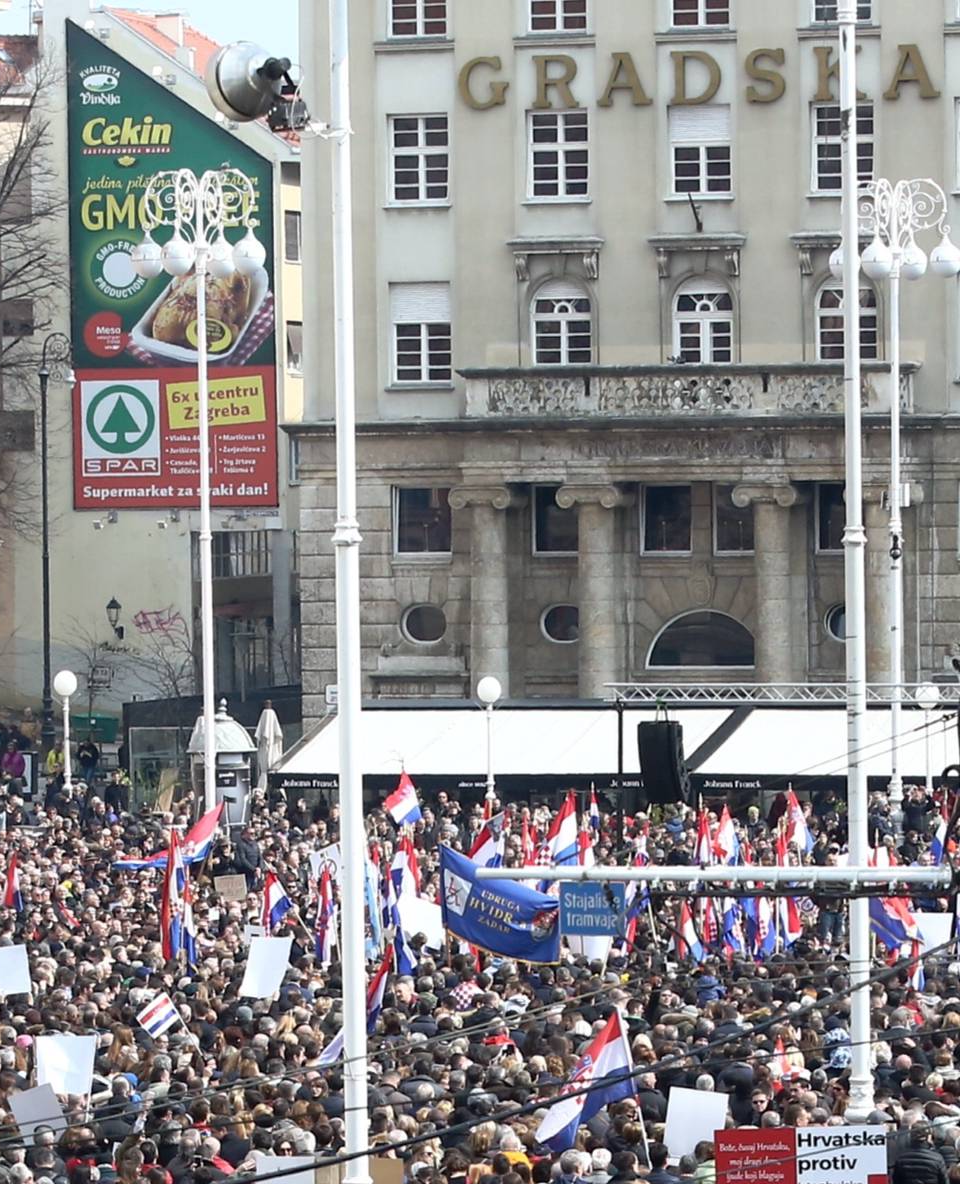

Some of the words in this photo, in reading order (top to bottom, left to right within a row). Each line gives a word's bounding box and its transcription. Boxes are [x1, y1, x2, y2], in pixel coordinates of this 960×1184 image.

[79, 64, 121, 79] KVALITETA
[457, 44, 940, 110] GRADSKA
[80, 92, 121, 106] Vindija
[82, 115, 172, 146] Cekin
[82, 175, 122, 194] jedina
[81, 193, 163, 231] GMO
[94, 276, 146, 298] PRODUCTION
[96, 326, 121, 335] Meso
[171, 391, 190, 403] 6x
[208, 386, 259, 400] centru
[86, 459, 157, 473] SPAR
[83, 485, 174, 500] Supermarket
[177, 488, 193, 497] za
[236, 482, 269, 496] dan!
[281, 779, 311, 788] Johann
[704, 779, 733, 788] Johann
[734, 779, 762, 787] Franck
[481, 888, 521, 914] UDRUGA
[477, 915, 512, 935] ZADAR
[797, 1131, 886, 1148] Hrvatska
[798, 1154, 857, 1175] protiv
